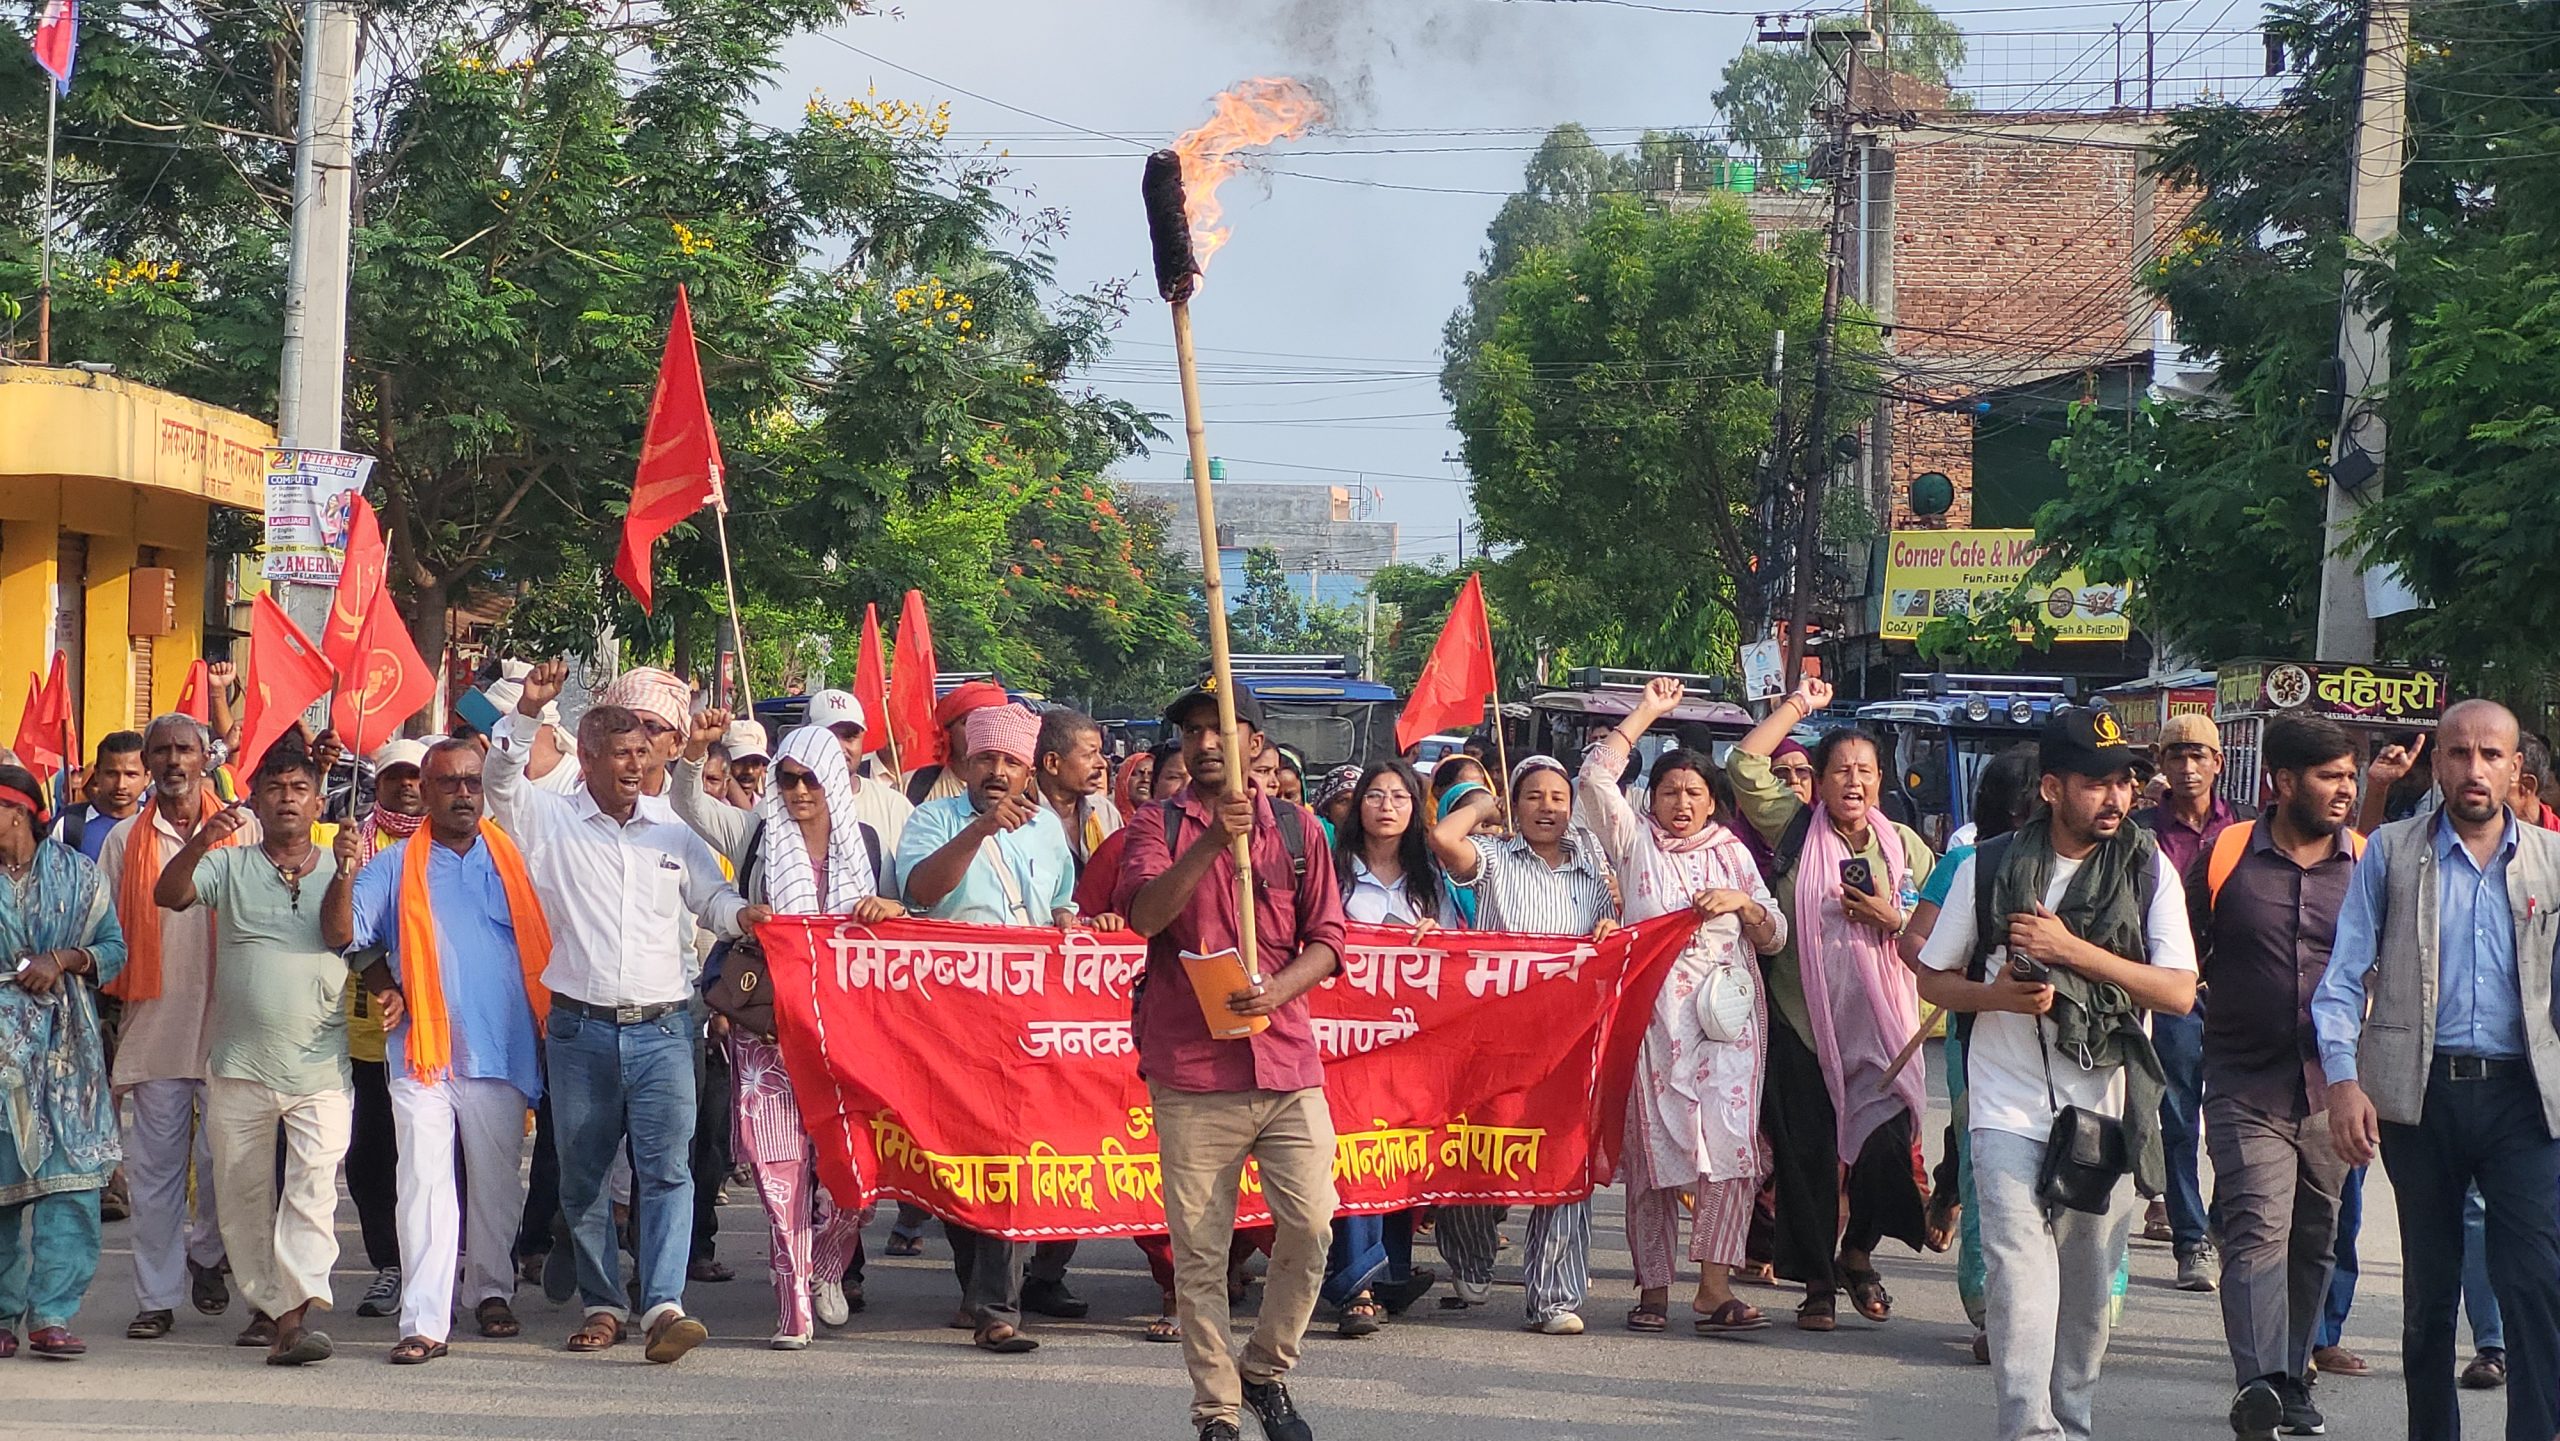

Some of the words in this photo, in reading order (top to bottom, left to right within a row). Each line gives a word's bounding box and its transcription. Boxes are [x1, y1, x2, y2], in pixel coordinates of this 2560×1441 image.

[335, 456, 363, 469] SEE?
[271, 517, 308, 525] LANGUAGE
[1894, 540, 1945, 568] Corner
[1950, 540, 1986, 568] Cafe
[1990, 541, 2002, 567] &
[2012, 574, 2019, 583] &
[1886, 621, 1913, 634] CoZy
[2077, 624, 2083, 635] &
[2317, 666, 2438, 715] दहिपुरी
[826, 922, 1053, 1000] मिटरब्याज
[1440, 1113, 1547, 1181] नेपाल
